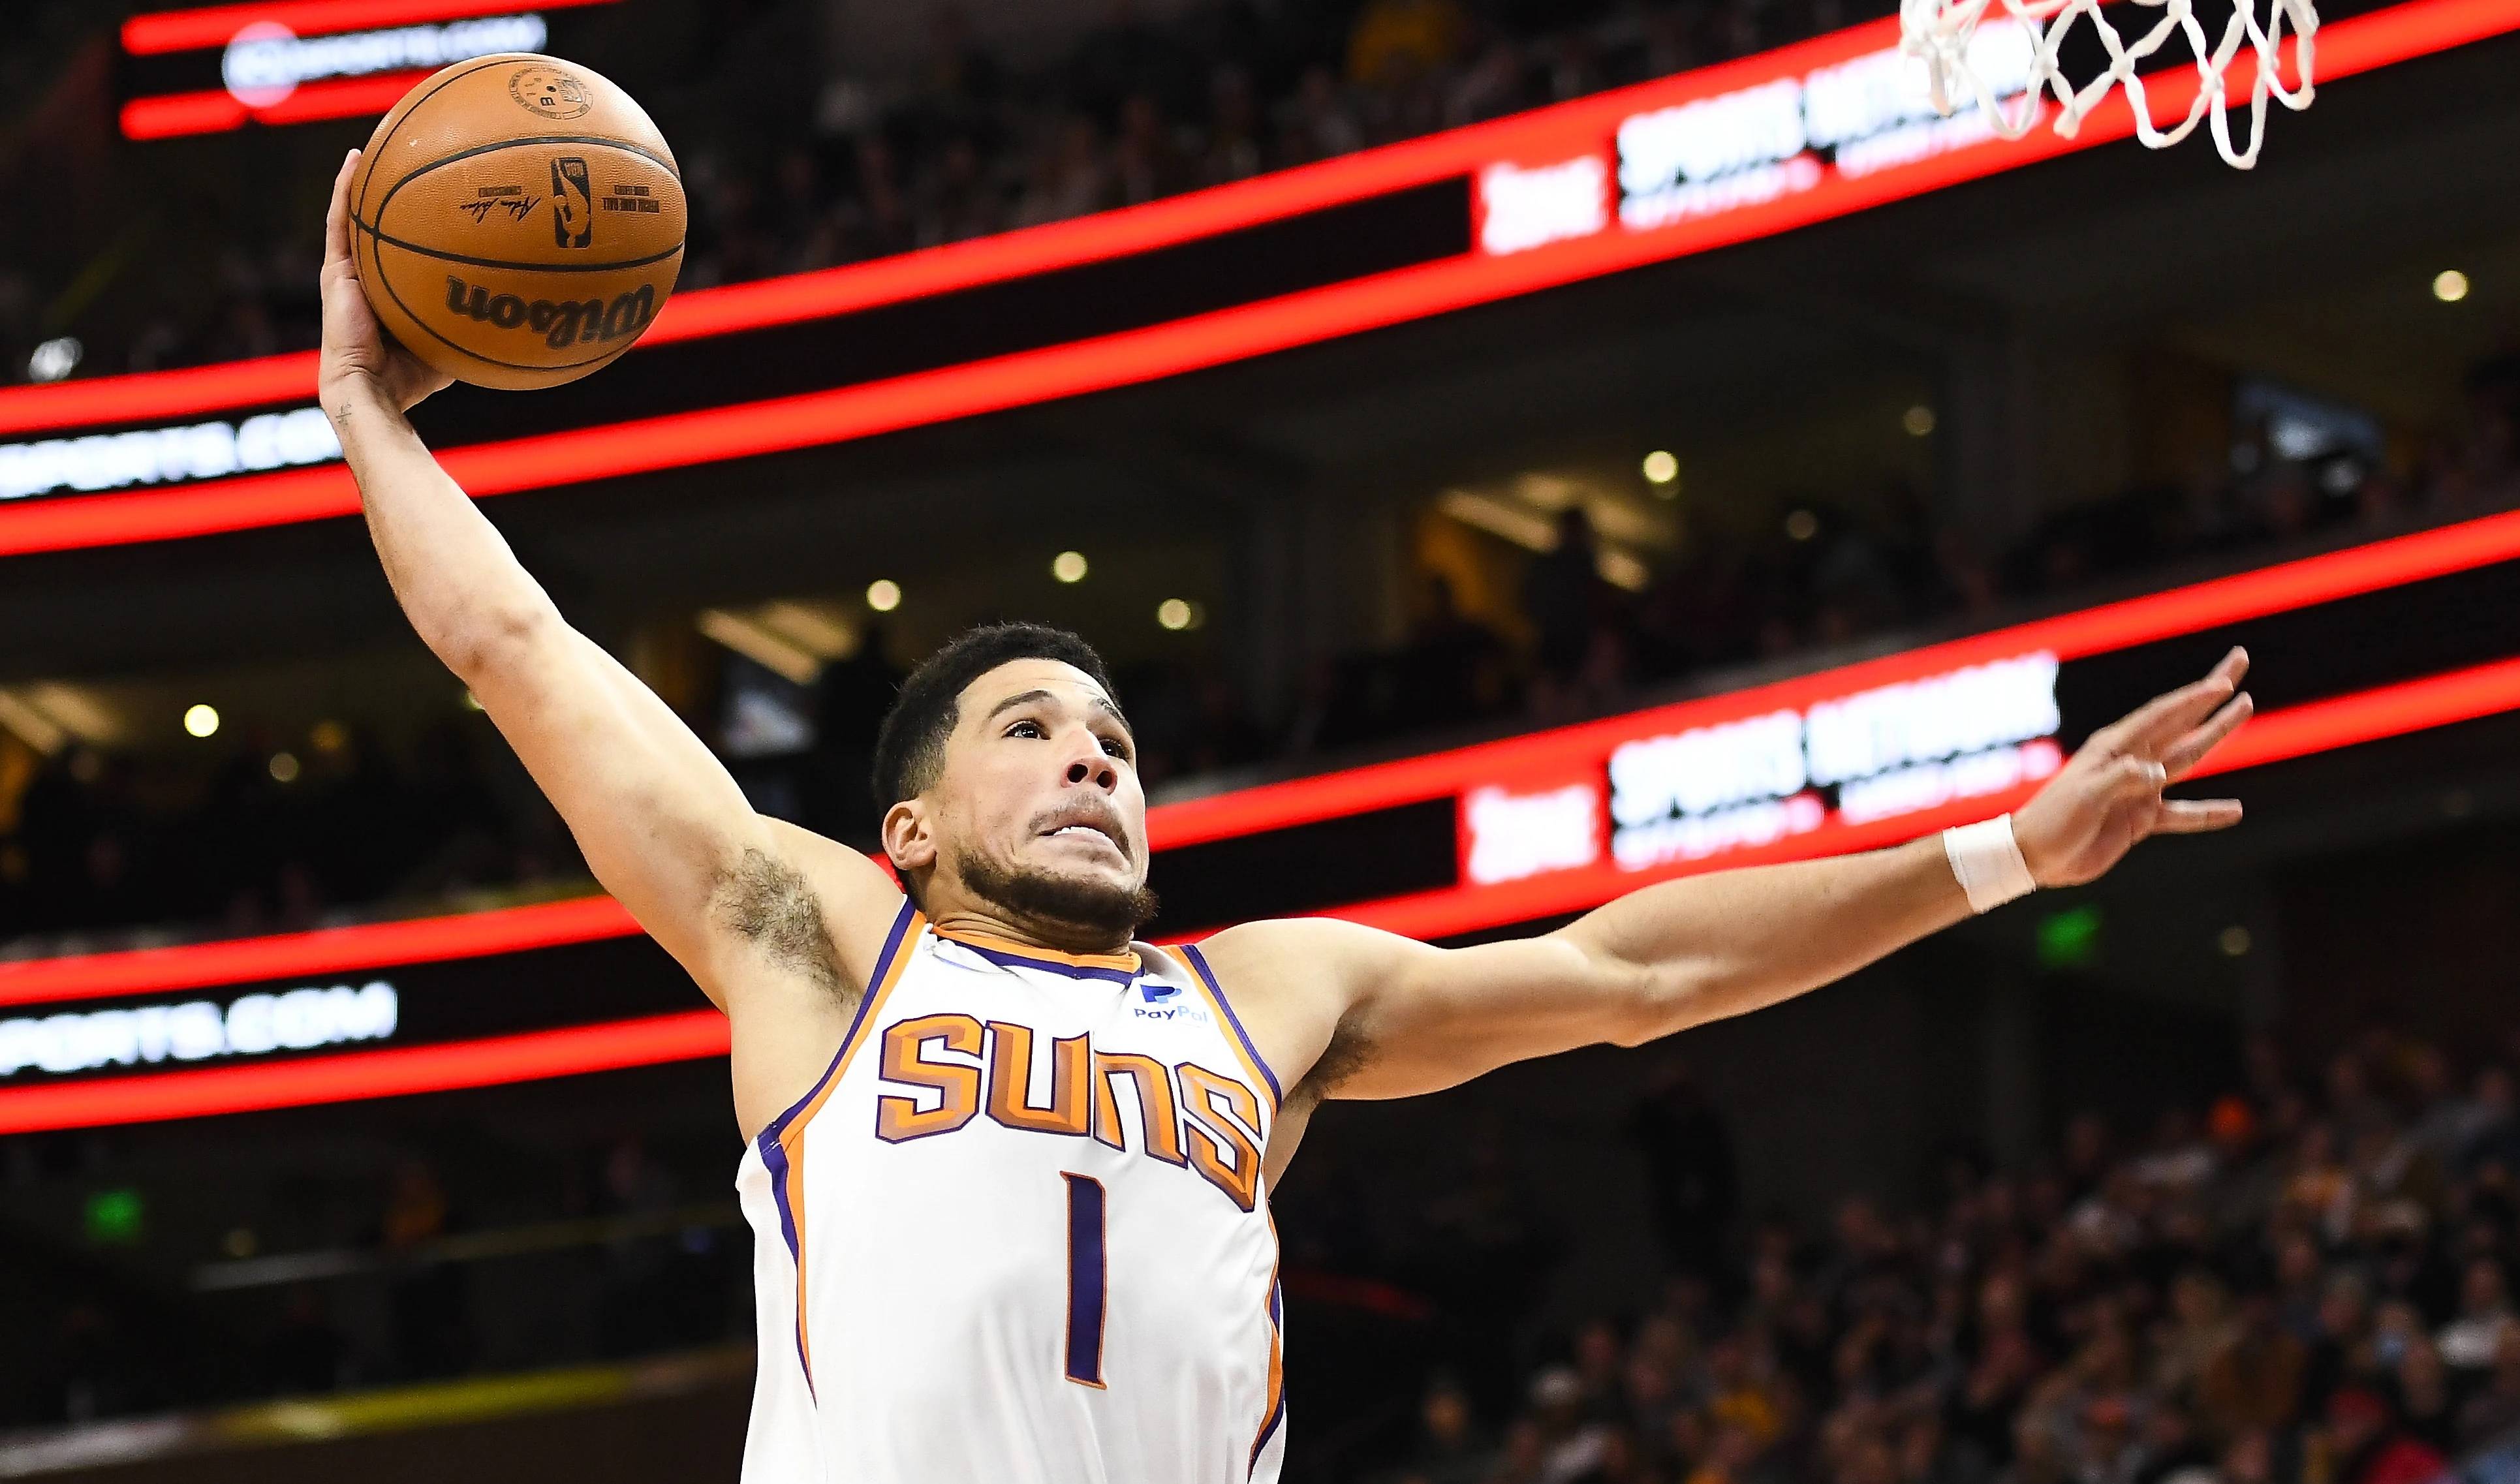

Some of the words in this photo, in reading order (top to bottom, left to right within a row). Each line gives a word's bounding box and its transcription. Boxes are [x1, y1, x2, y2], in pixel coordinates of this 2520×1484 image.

[448, 275, 653, 350] Wilson
[1134, 1006, 1207, 1023] PayPal
[875, 1013, 1264, 1213] SUNS
[1059, 1171, 1107, 1391] 1
